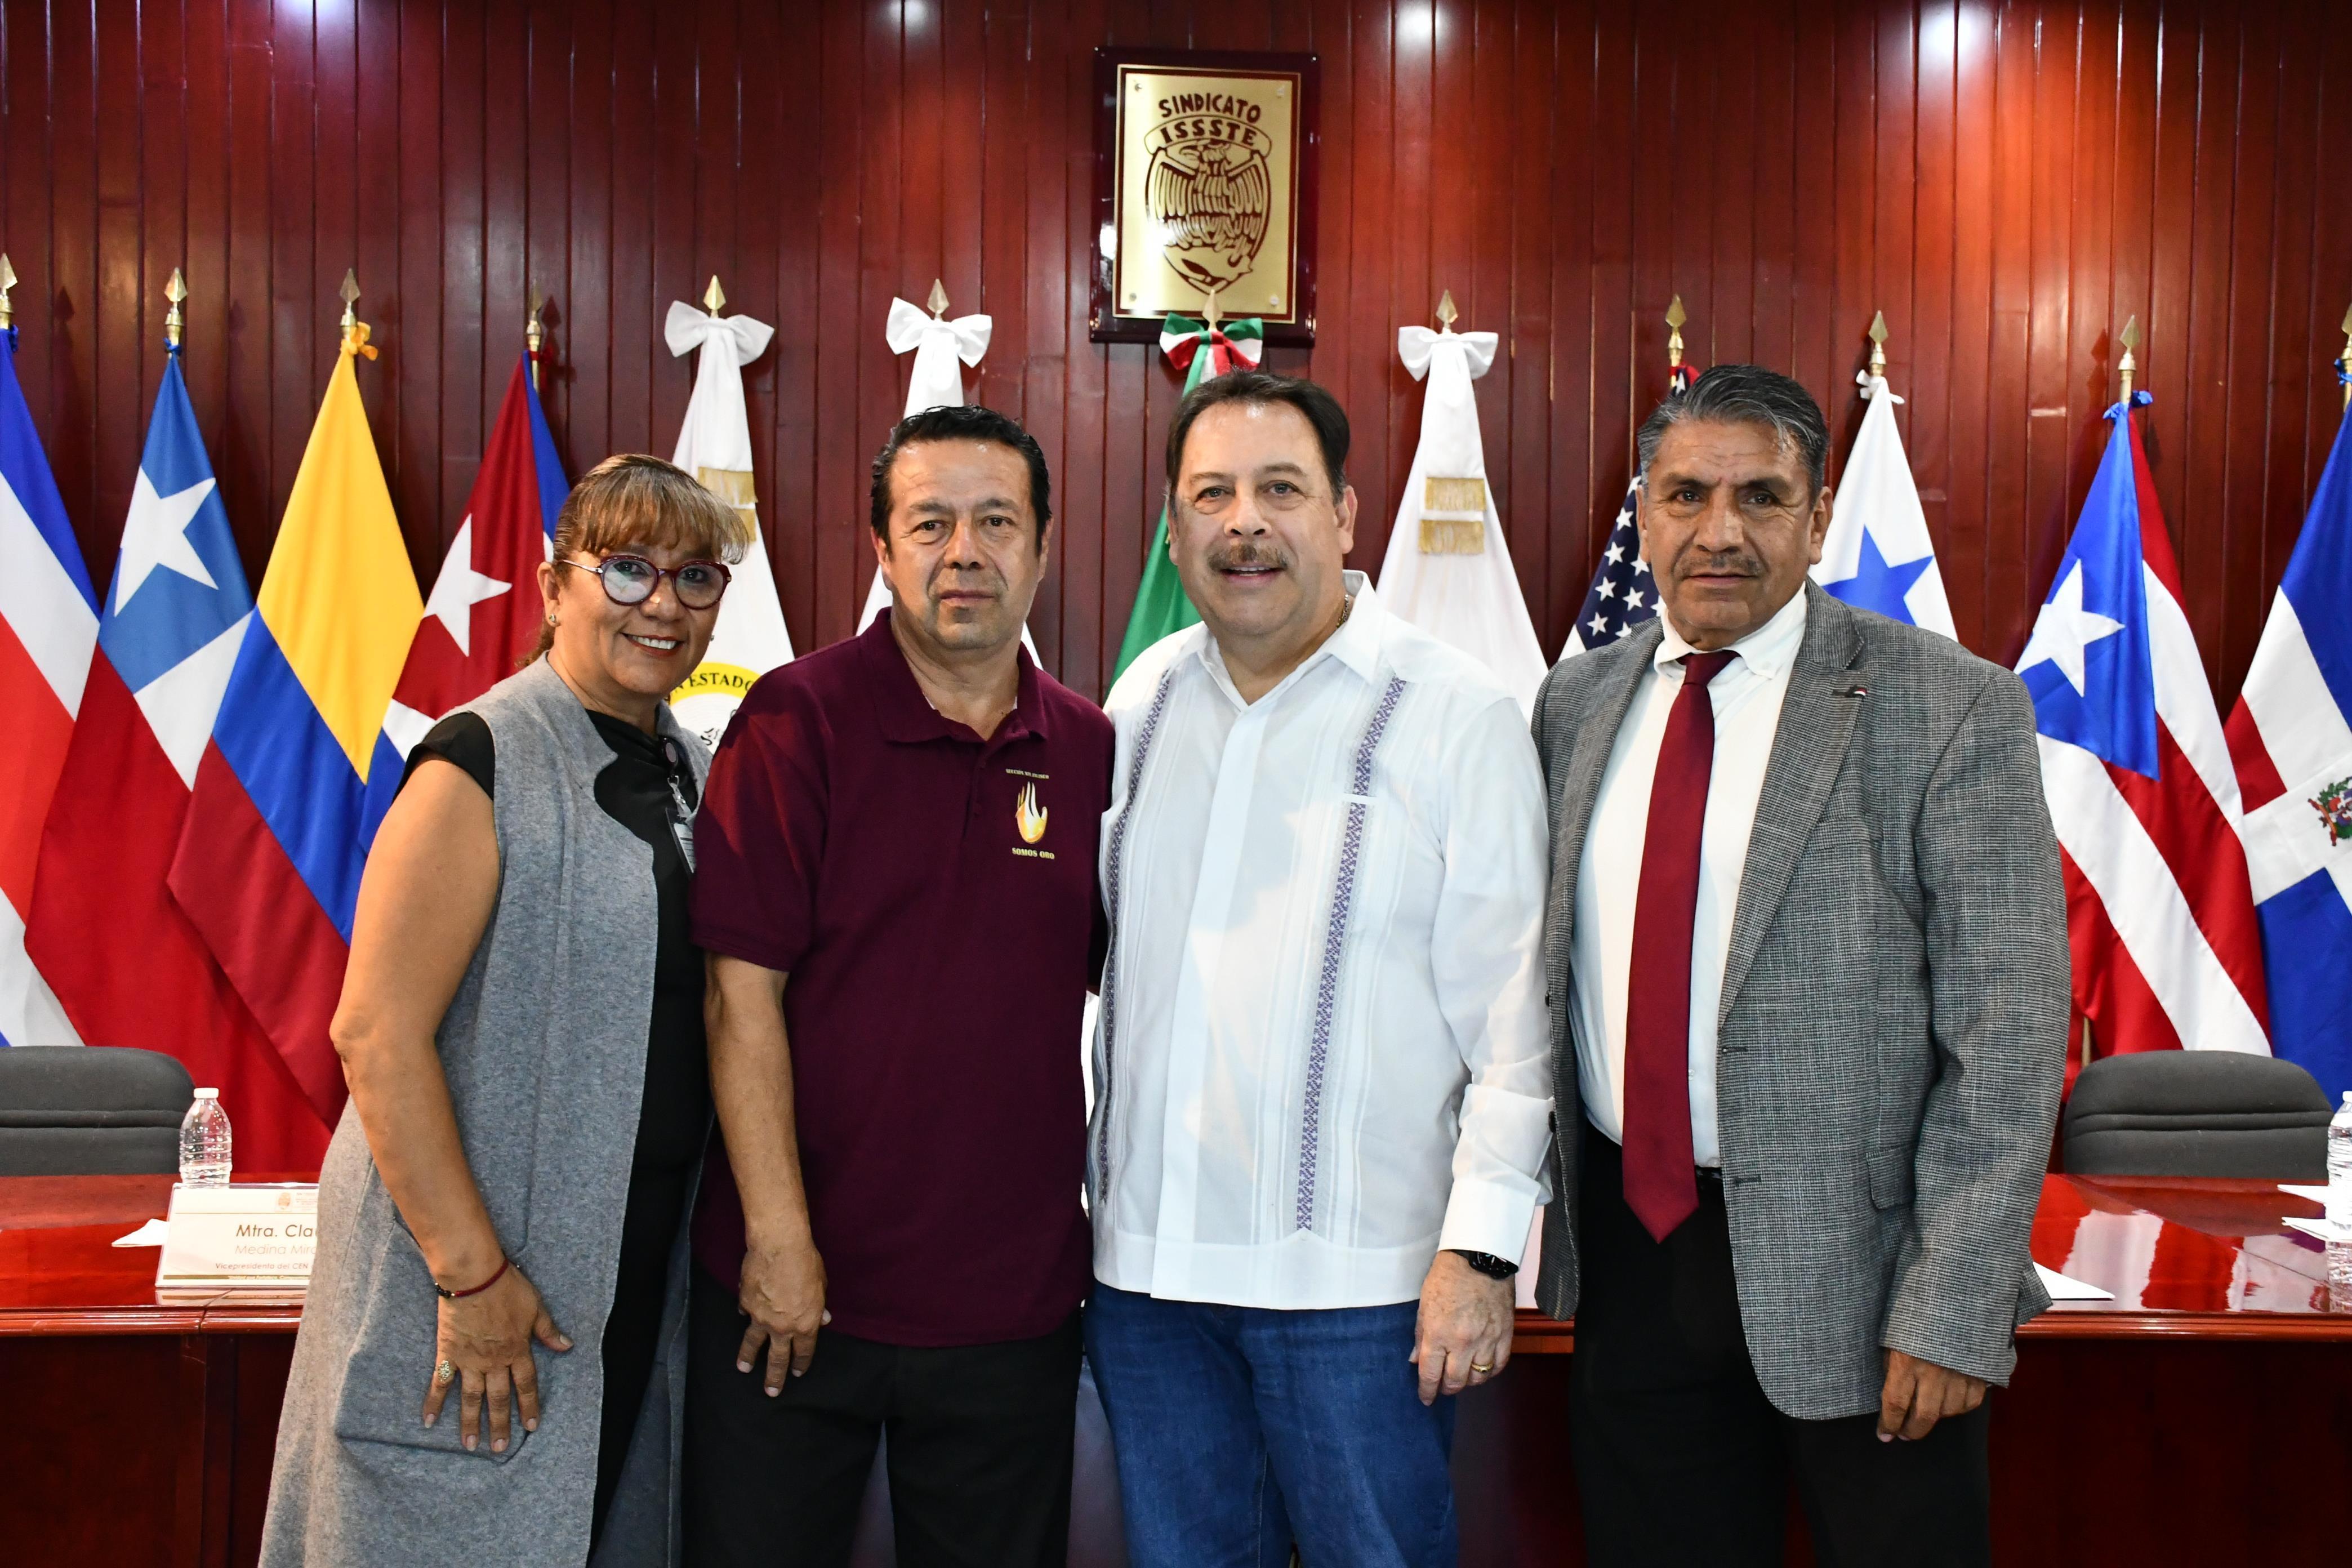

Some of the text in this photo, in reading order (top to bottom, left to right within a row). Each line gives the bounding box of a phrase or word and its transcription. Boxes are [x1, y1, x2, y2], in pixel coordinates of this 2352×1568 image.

[1159, 92, 1261, 123] SINDICATO
[1160, 119, 1257, 146] ISSSTE
[1012, 847, 1055, 859] SOMOS ORO
[235, 1224, 318, 1237] Mtra. Cla
[235, 1244, 287, 1255] Medina
